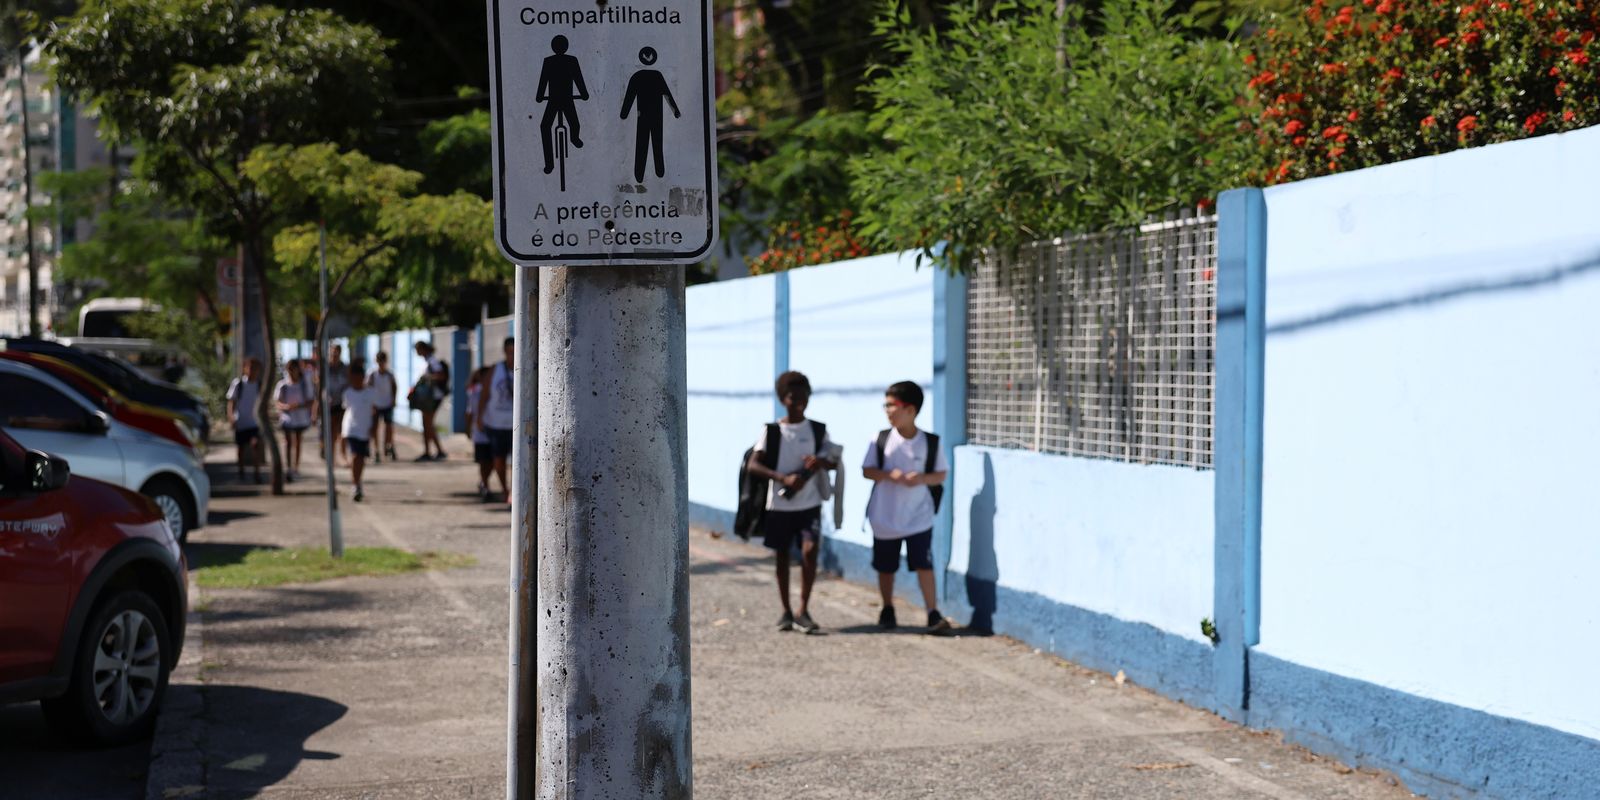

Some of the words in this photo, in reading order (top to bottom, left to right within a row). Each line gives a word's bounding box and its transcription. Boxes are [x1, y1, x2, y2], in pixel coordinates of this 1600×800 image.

[519, 6, 681, 28] Compartilhada
[534, 203, 549, 220] A
[557, 200, 680, 224] preferência
[531, 229, 544, 247] é
[552, 230, 579, 247] do
[588, 229, 683, 246] Pedestre
